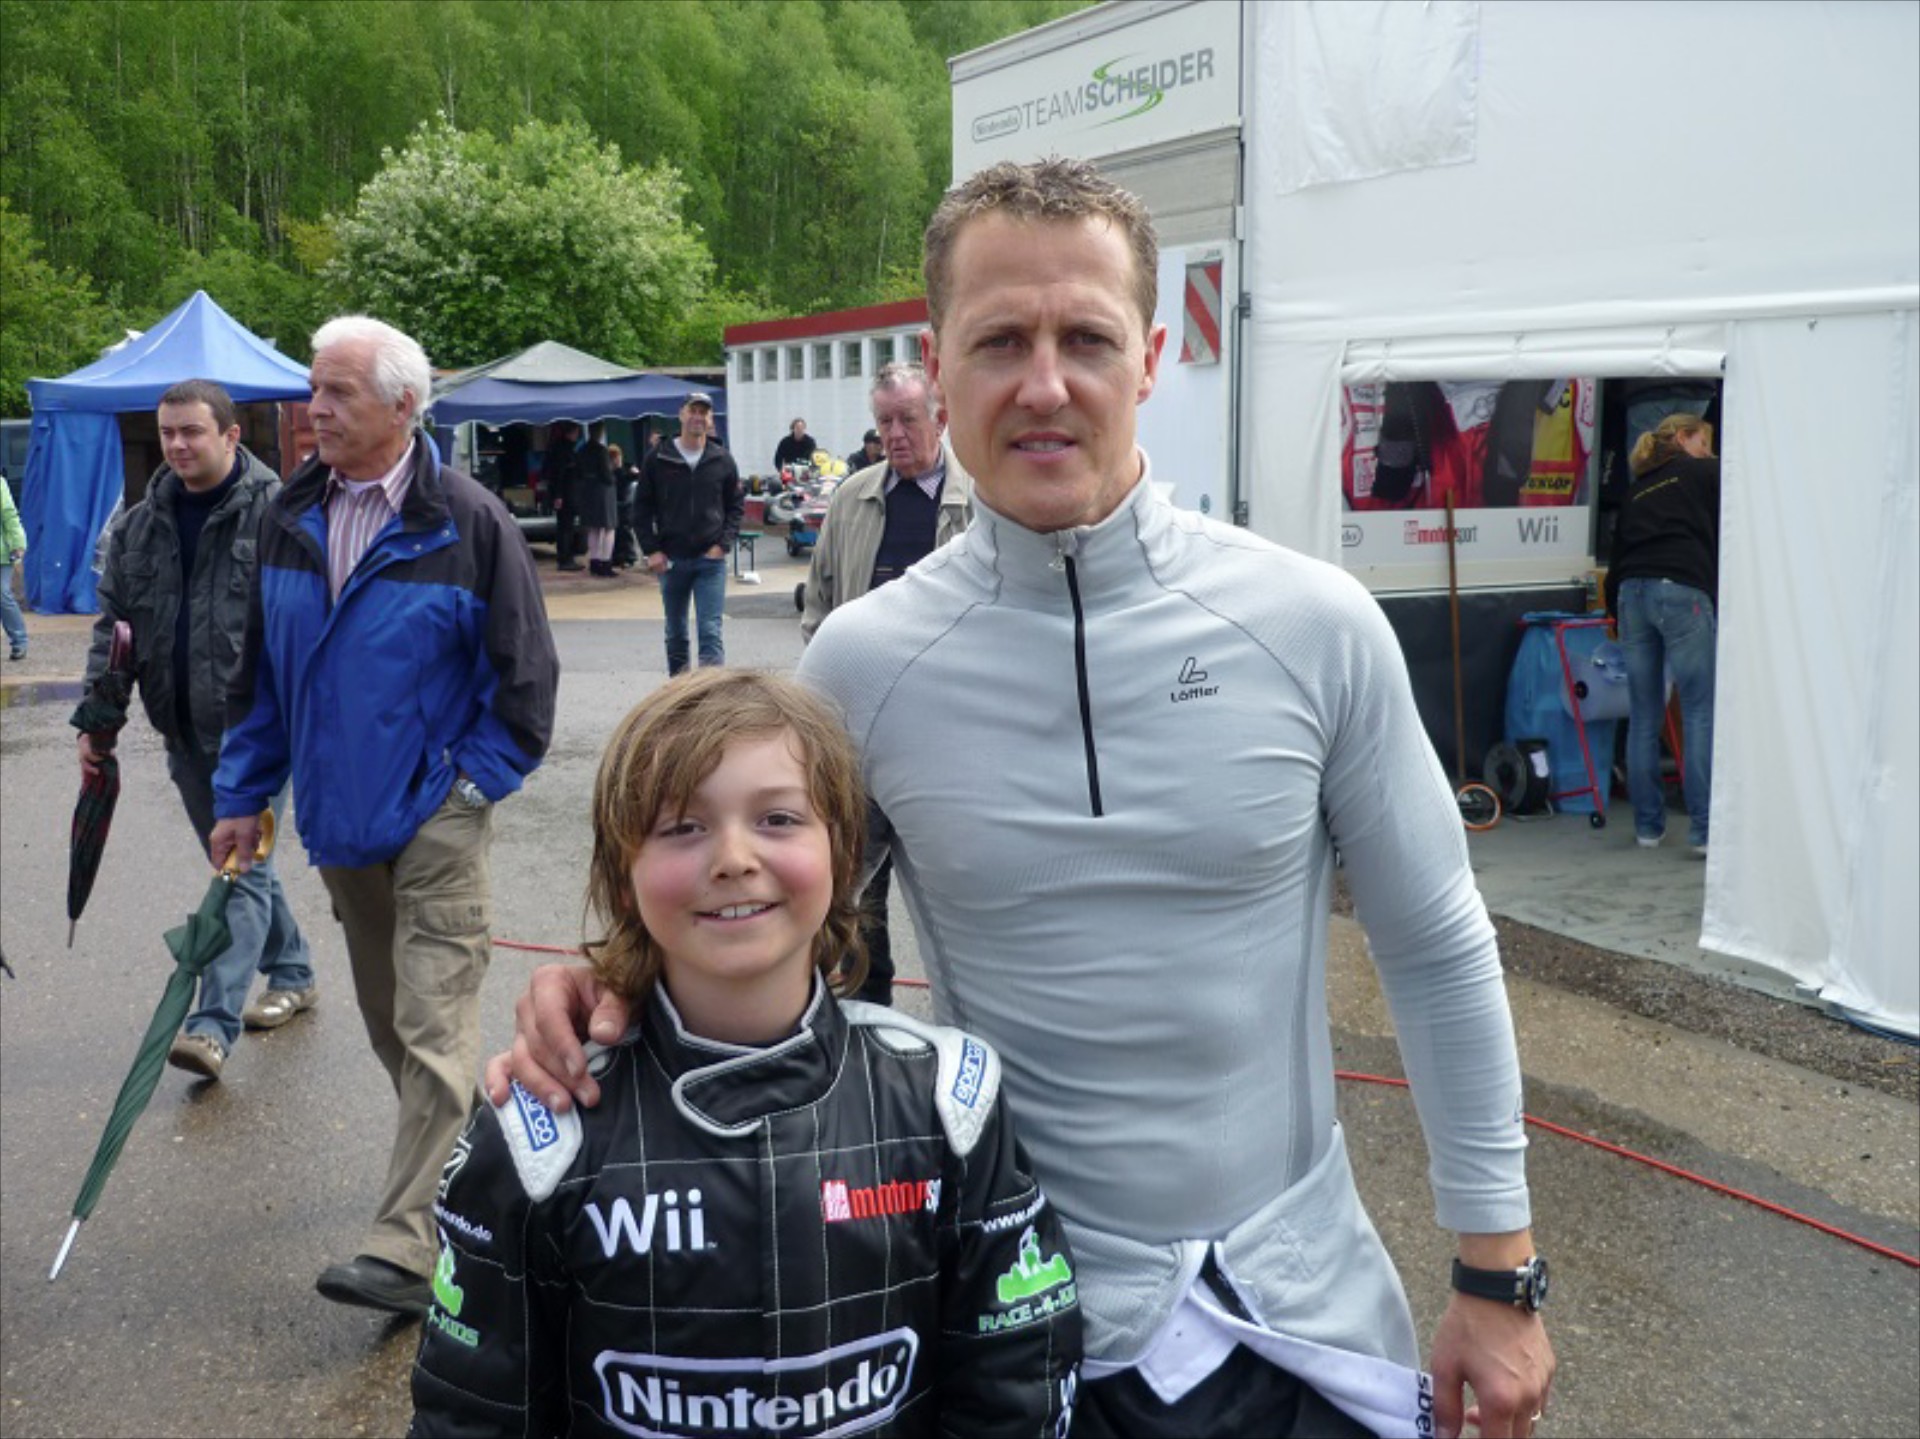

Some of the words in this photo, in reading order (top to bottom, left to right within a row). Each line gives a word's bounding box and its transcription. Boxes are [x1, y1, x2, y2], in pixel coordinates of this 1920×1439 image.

[1517, 515, 1558, 543] Wii
[584, 1187, 704, 1258] Wii
[617, 1359, 899, 1430] Nintendo
